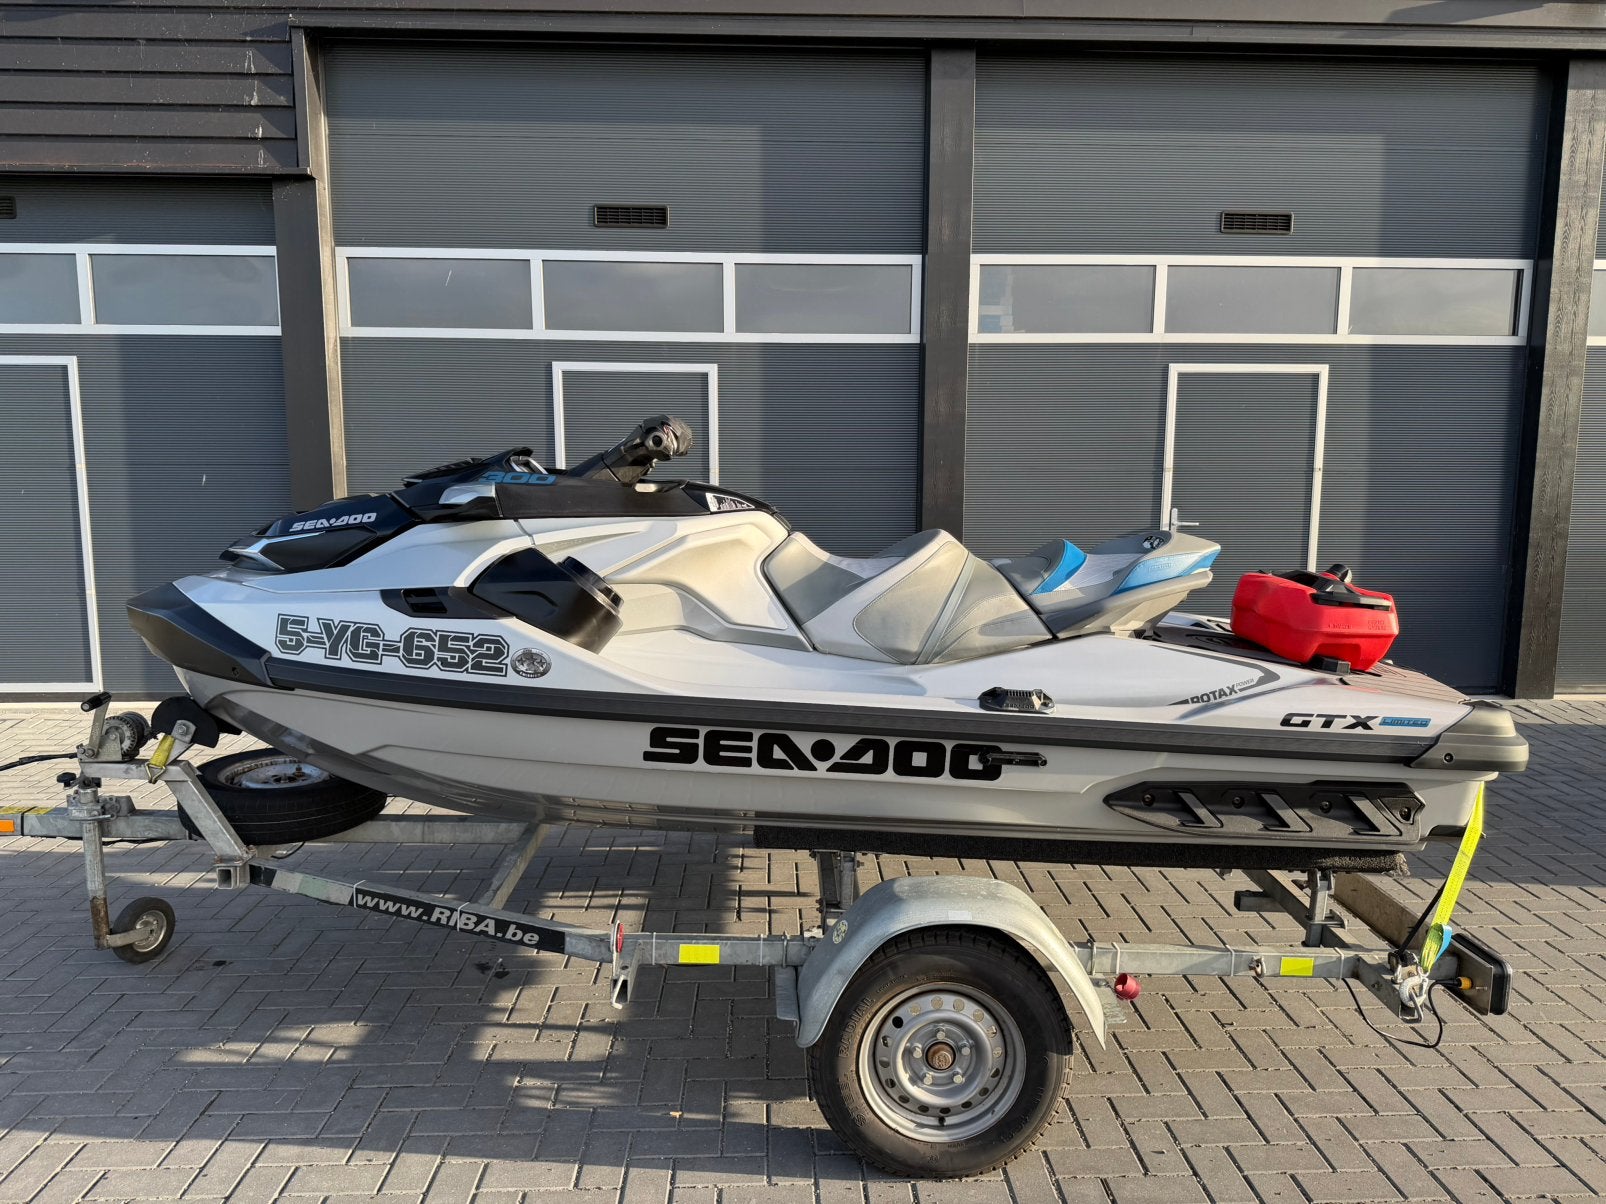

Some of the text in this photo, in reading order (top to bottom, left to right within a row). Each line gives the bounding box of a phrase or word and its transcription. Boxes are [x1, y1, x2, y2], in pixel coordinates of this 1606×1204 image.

[479, 471, 557, 485] 300
[274, 613, 510, 677] 5-YG-652
[1189, 677, 1255, 704] ROTAX POWER
[1279, 712, 1430, 731] GTX LIMITED
[357, 893, 540, 945] www.RIBA.be
